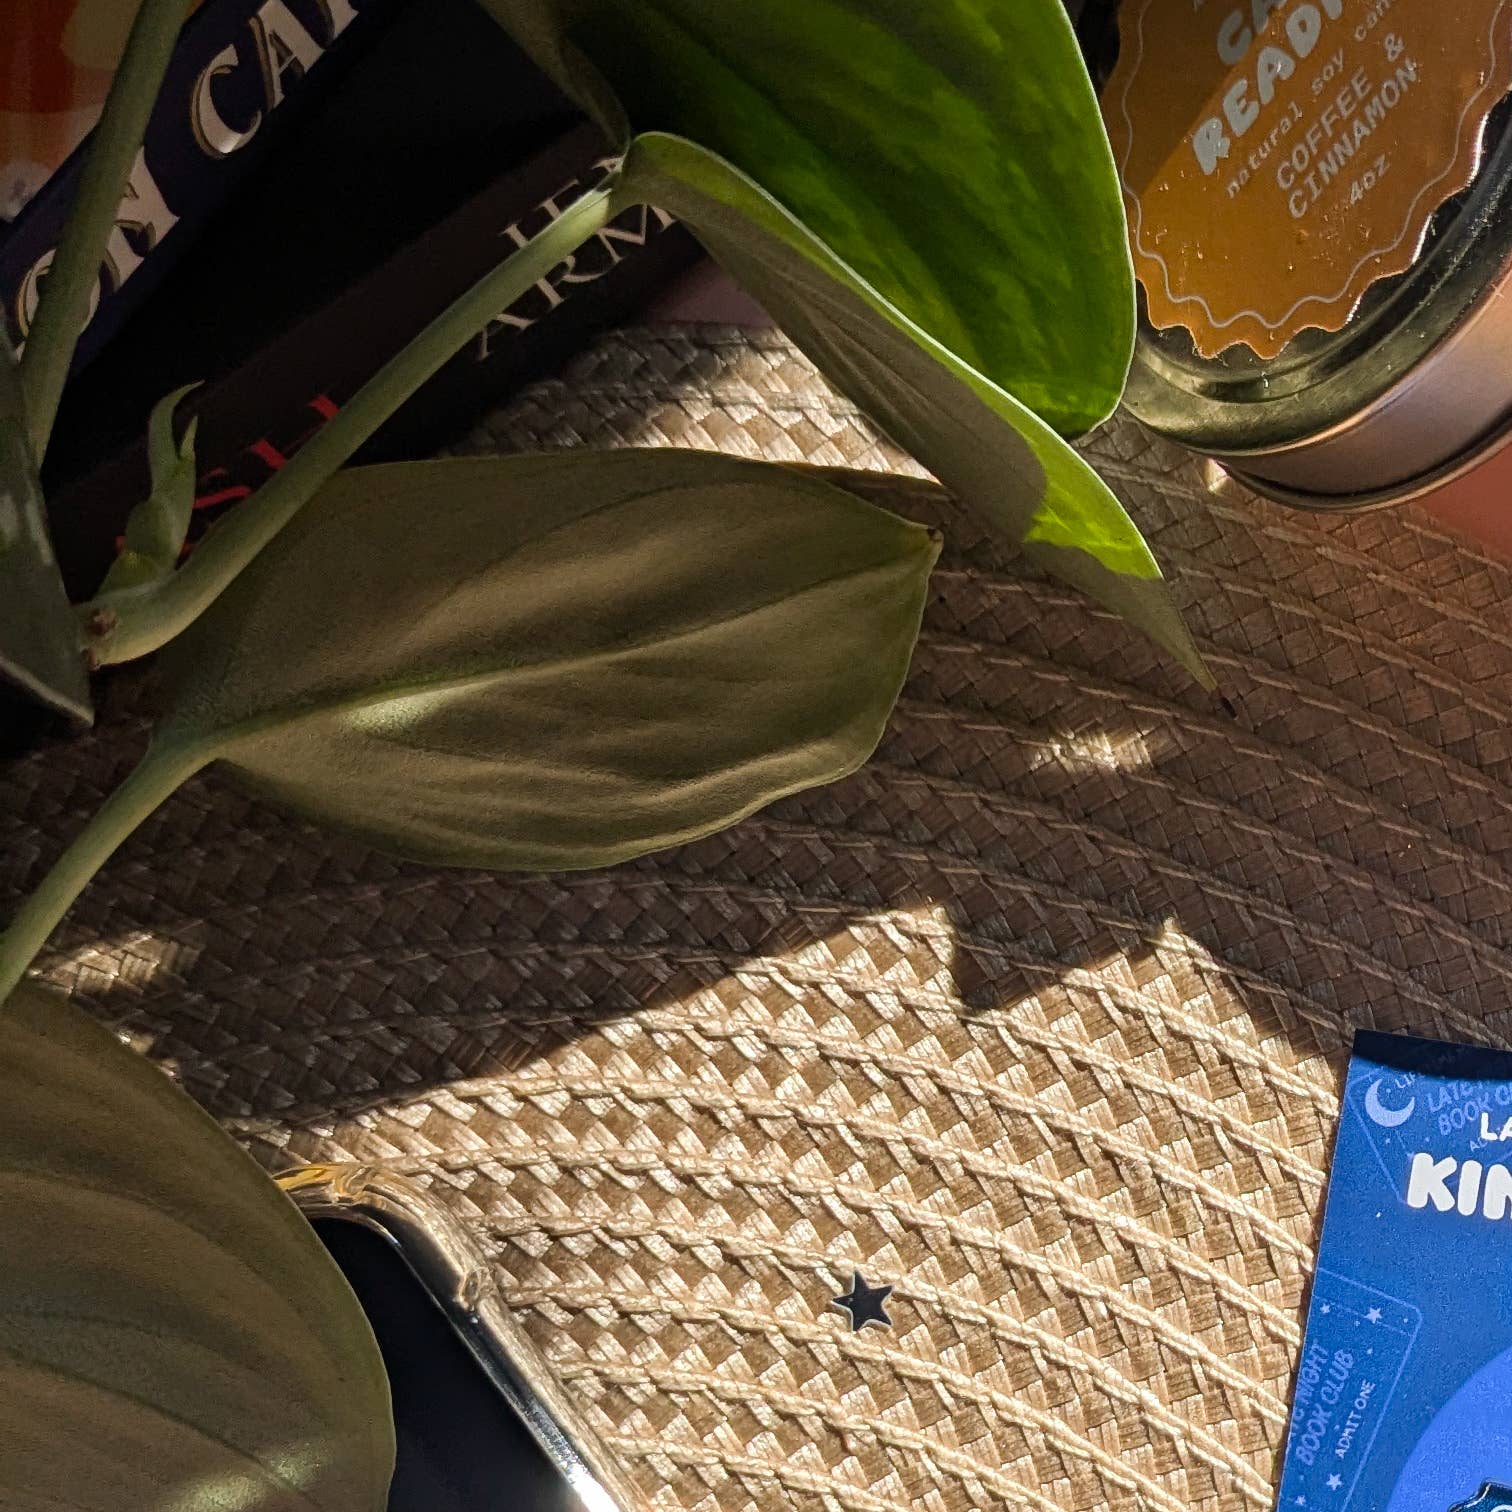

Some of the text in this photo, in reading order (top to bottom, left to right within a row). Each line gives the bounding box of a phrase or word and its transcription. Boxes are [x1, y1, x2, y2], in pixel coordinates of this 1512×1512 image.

[190, 0, 359, 159] CA
[1227, 101, 1303, 198] natural
[1312, 49, 1344, 95] soy
[1277, 33, 1405, 190] COFFEE &
[1289, 56, 1418, 218] CINNAMON
[1354, 1379, 1377, 1411] ONE
